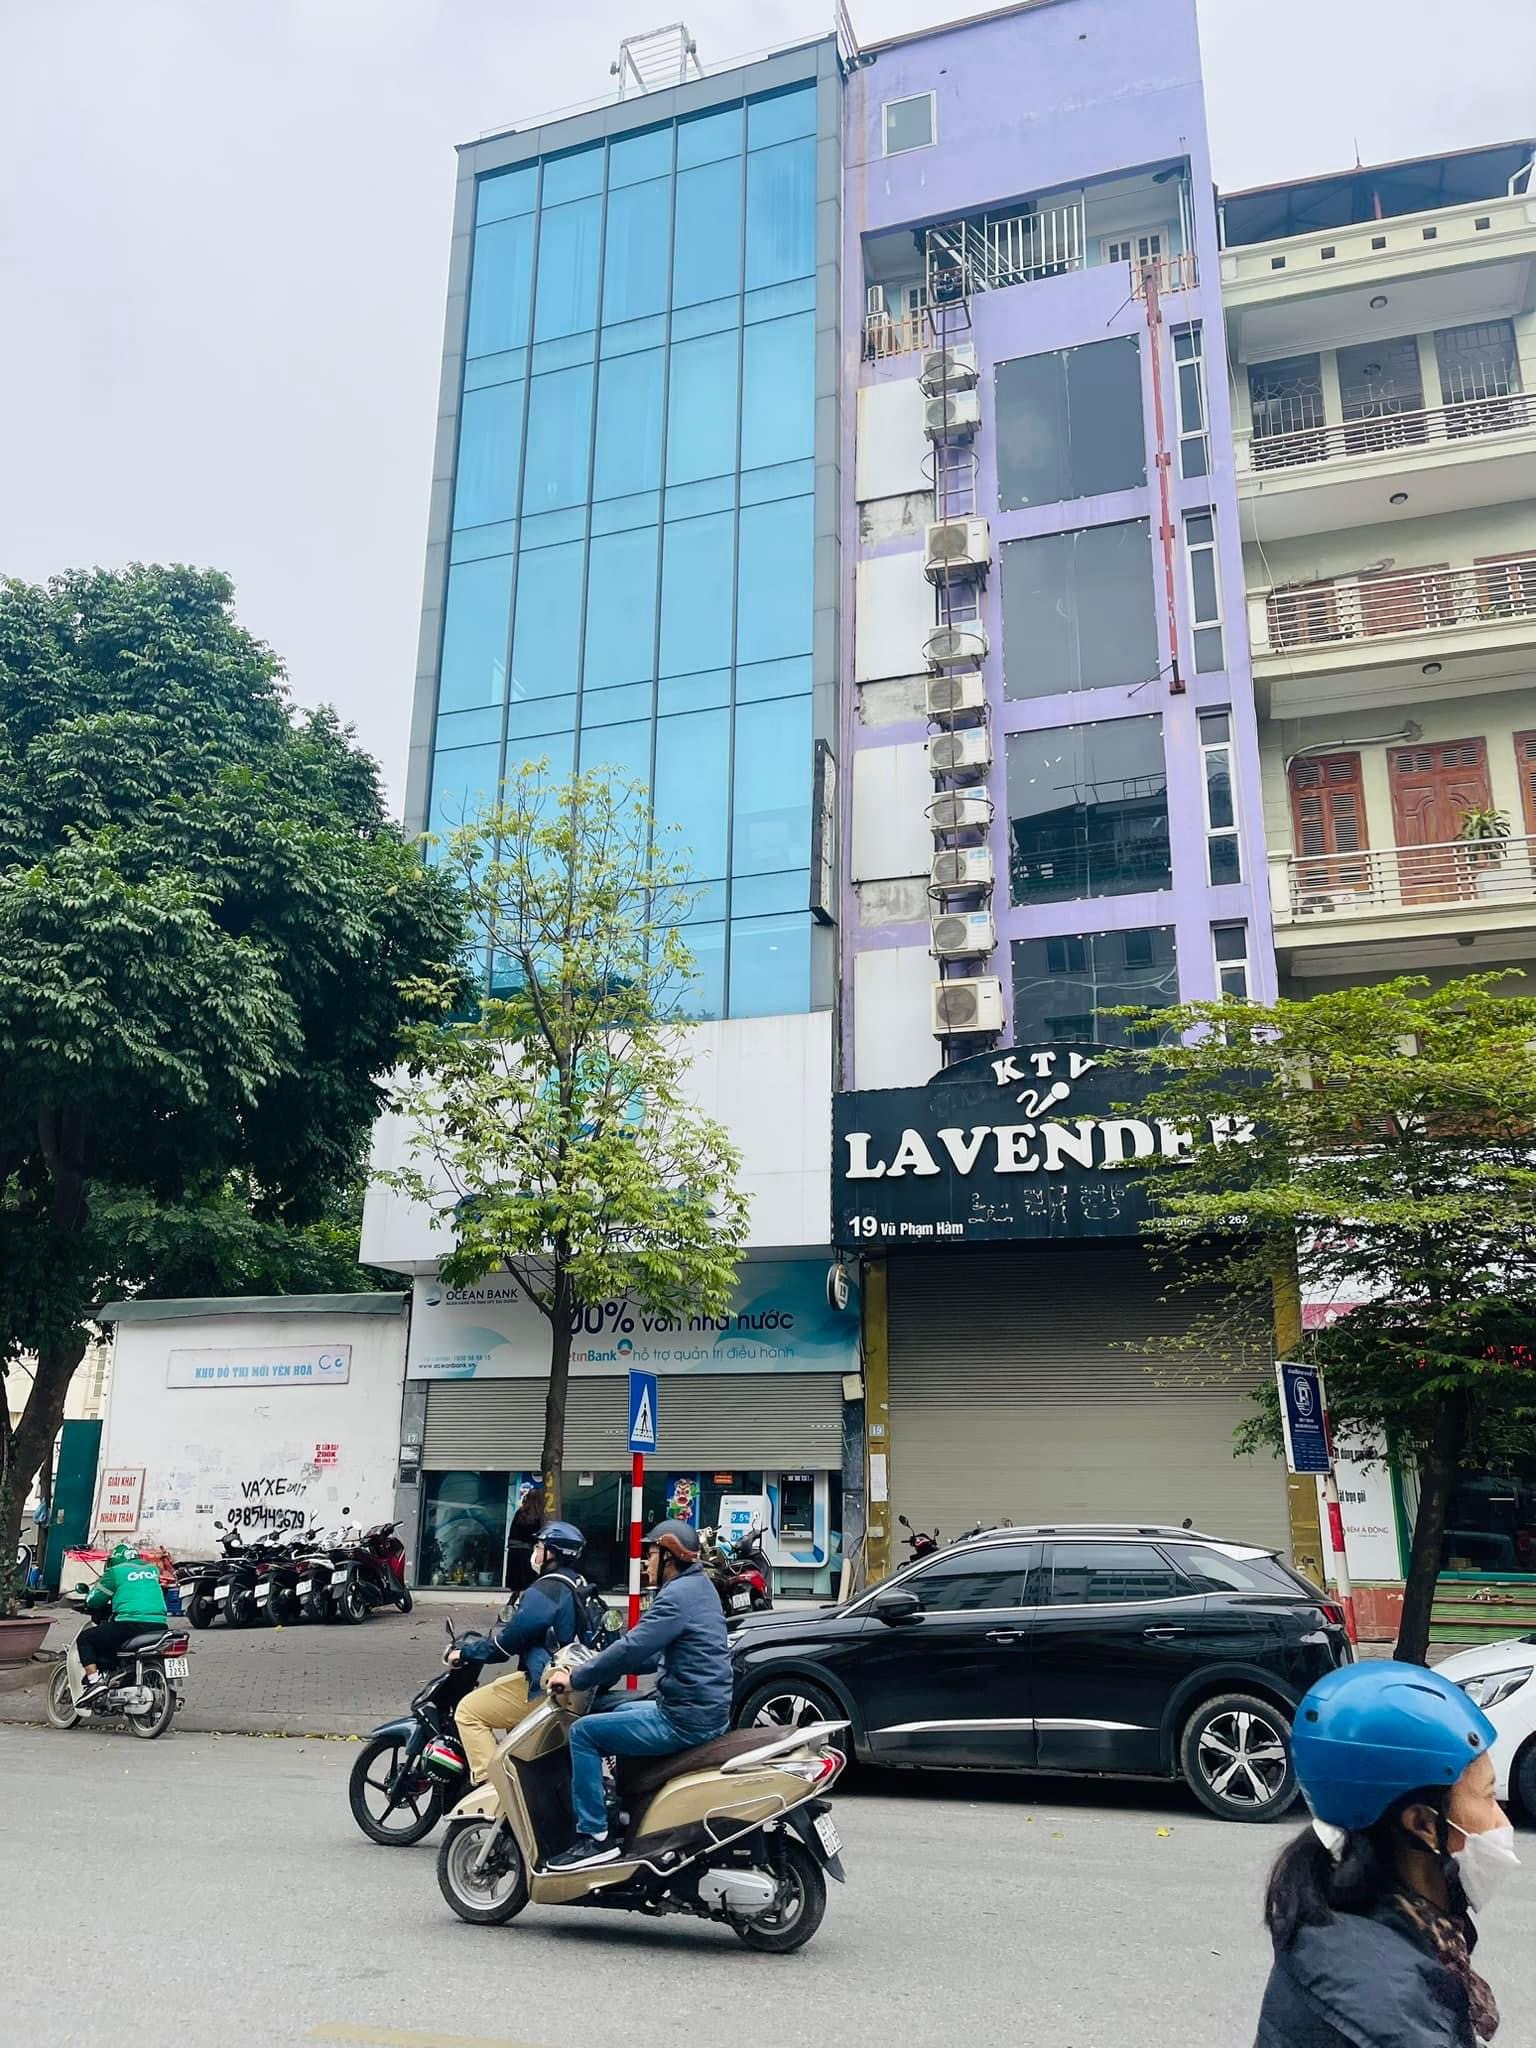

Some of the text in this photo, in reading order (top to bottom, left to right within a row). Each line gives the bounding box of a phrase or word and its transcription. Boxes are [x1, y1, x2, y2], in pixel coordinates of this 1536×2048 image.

[991, 1051, 1097, 1086] KTV
[849, 1216, 964, 1238] 19 Vũ Phạm Hàm
[446, 1288, 519, 1301] OCEAN BANK
[569, 1301, 635, 1334] 00%
[738, 1309, 794, 1331] nước
[569, 1349, 617, 1361] tinBank
[194, 1367, 215, 1378] KHU
[264, 1478, 288, 1496] XE
